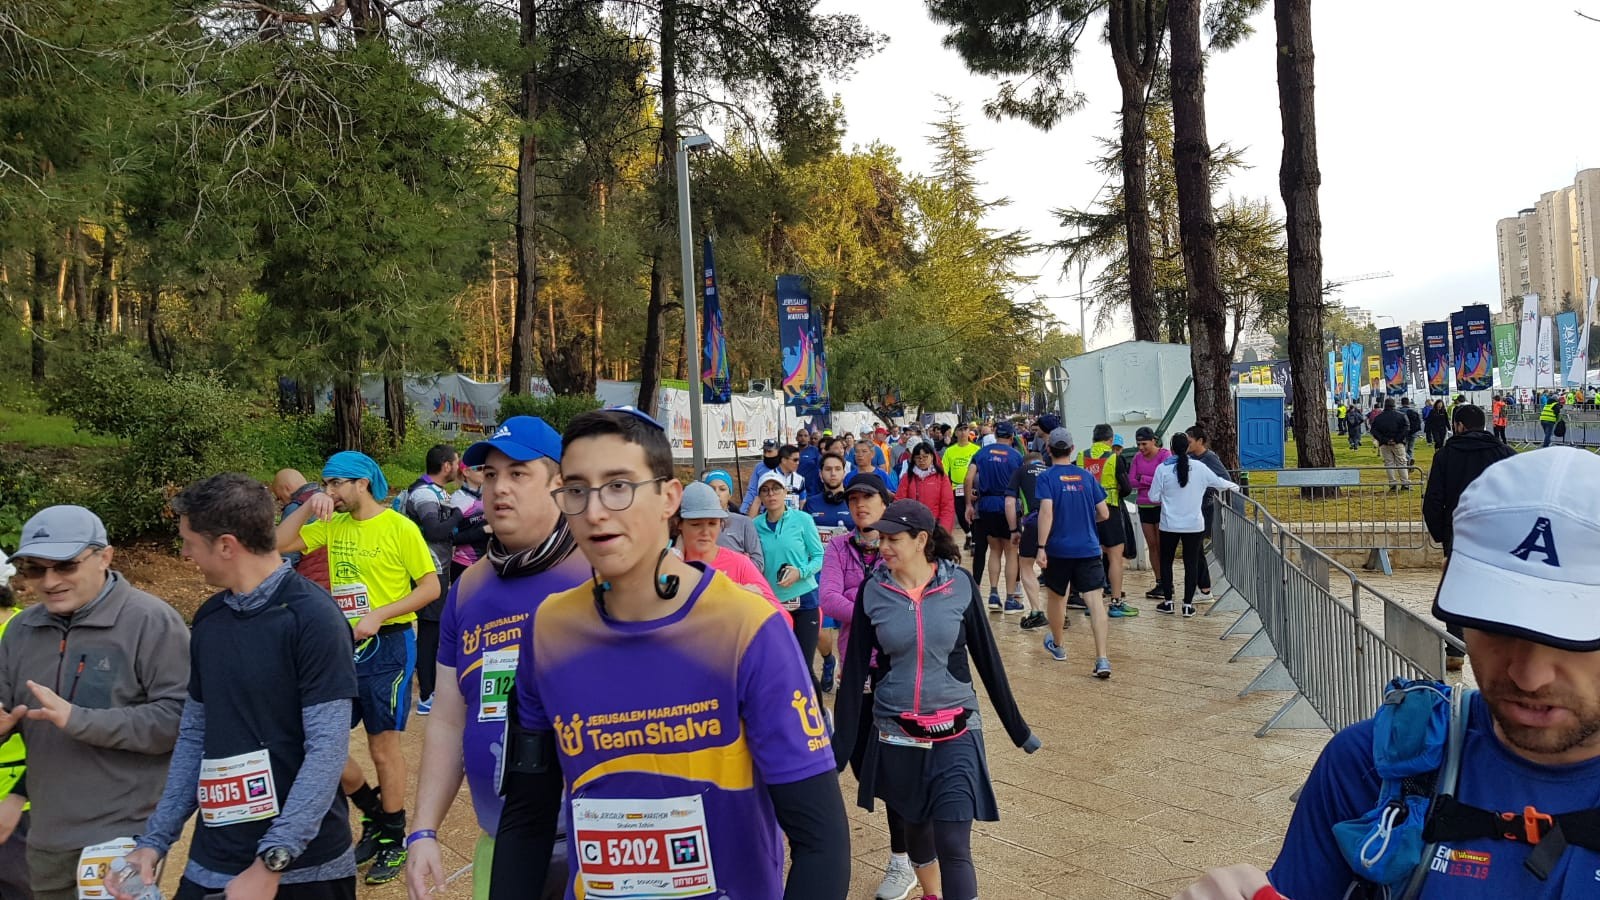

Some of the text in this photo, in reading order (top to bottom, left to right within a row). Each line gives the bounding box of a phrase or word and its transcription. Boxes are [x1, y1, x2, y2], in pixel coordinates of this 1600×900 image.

[483, 627, 522, 647] Team
[484, 676, 515, 695] B 12
[586, 699, 719, 727] JERUSALEM MARATHON'S
[587, 717, 722, 750] Team Shalva
[209, 782, 240, 803] 4675
[584, 838, 660, 866] C 5202
[1458, 851, 1489, 863] Winner
[83, 863, 108, 879] A 3
[1431, 857, 1448, 873] ON
